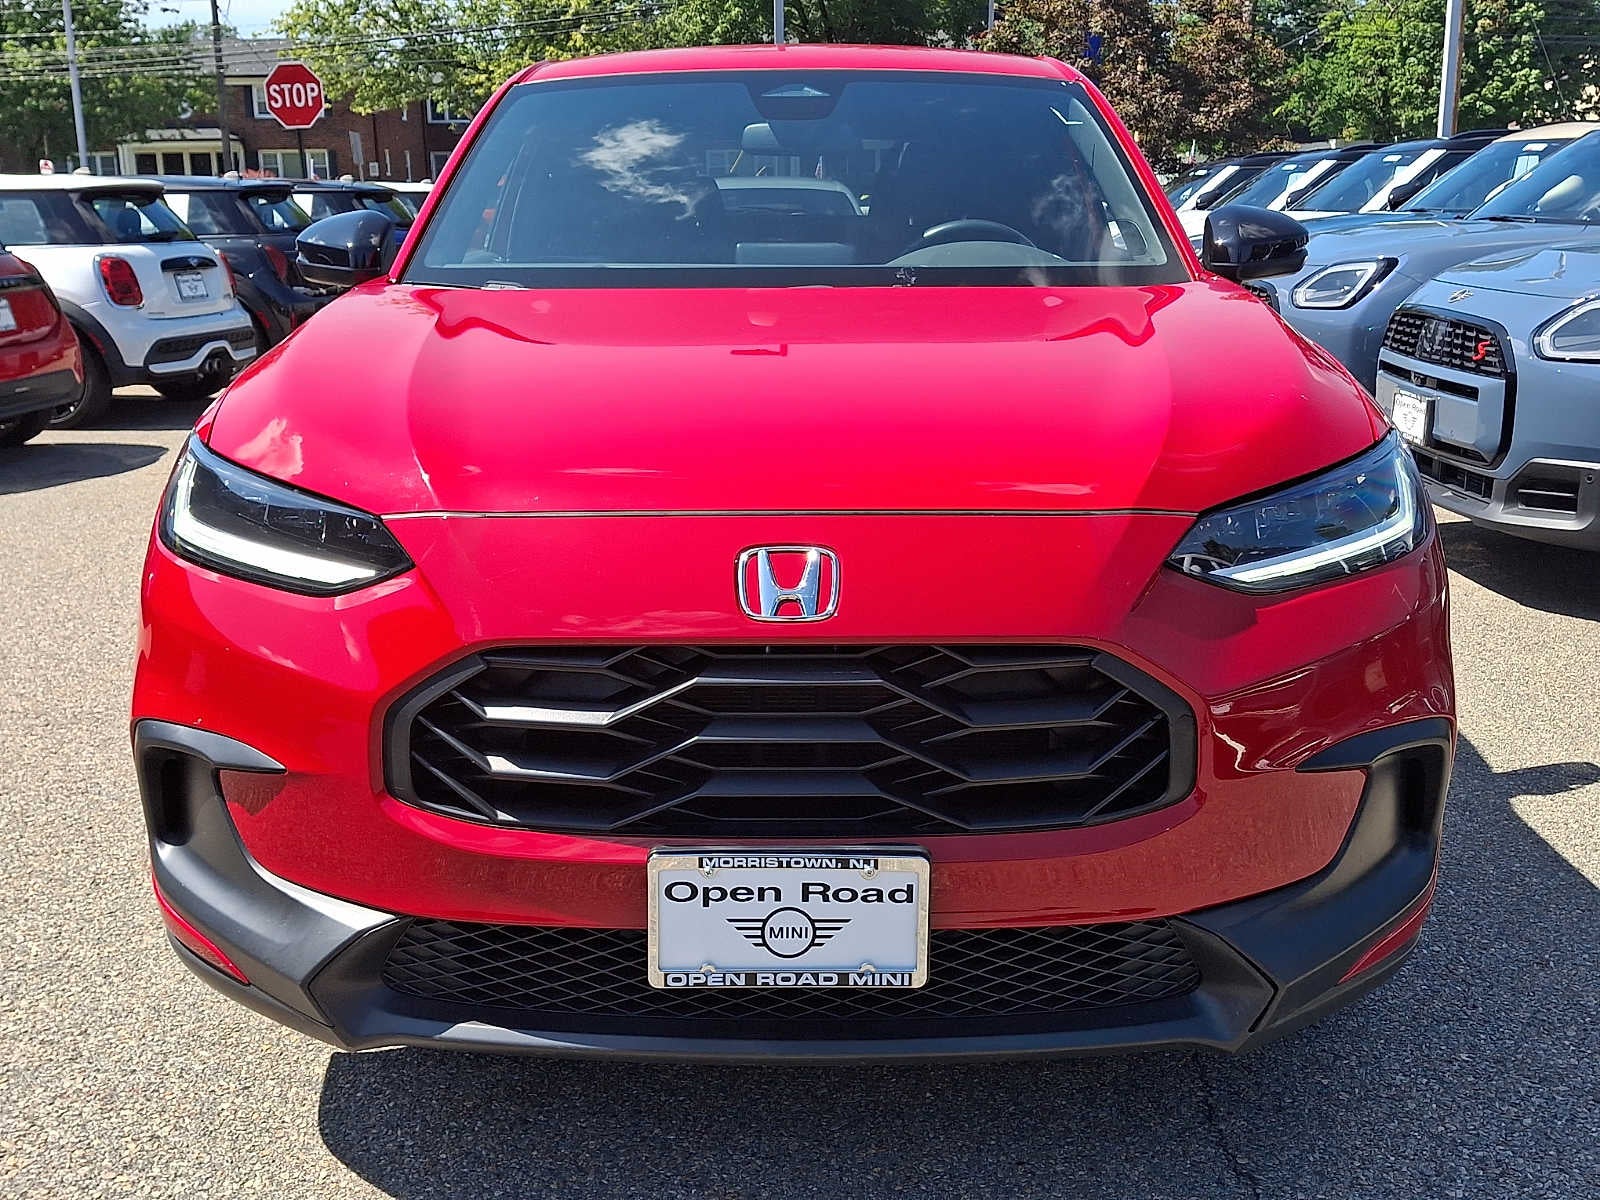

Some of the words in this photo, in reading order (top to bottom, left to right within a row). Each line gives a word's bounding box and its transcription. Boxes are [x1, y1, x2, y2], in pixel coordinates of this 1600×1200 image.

[269, 83, 319, 108] STOP
[702, 857, 842, 869] MORRISTOWN,
[849, 857, 875, 869] NJ
[664, 881, 782, 908] Open
[801, 882, 914, 904] Road
[768, 926, 809, 939] MINI
[666, 973, 746, 987] OPEN
[756, 973, 839, 987] ROAD
[848, 973, 910, 987] MINI
